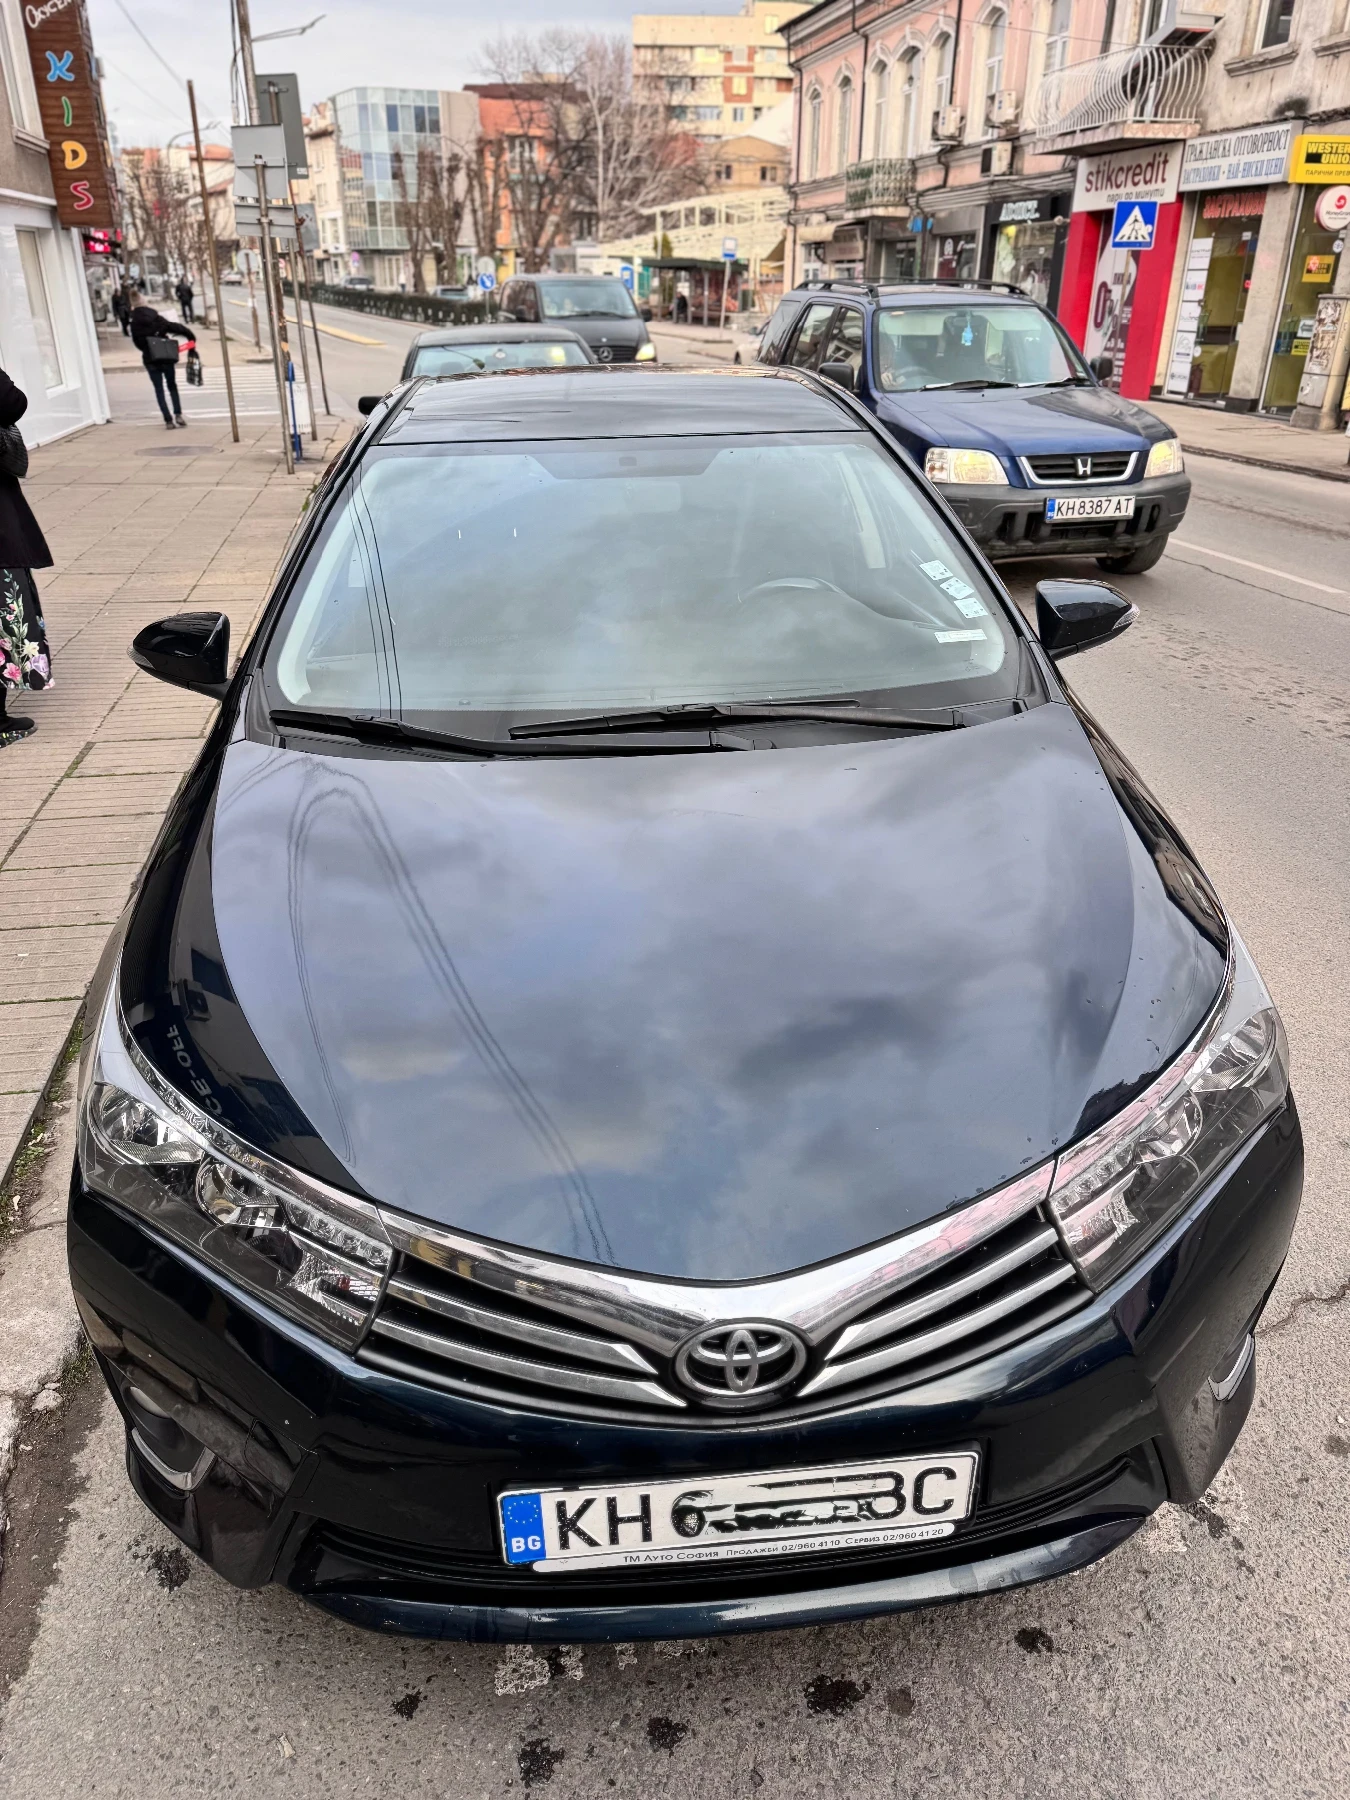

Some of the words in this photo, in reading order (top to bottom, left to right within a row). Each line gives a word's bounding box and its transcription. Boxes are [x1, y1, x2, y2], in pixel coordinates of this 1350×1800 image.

[46, 51, 94, 210] KIDS
[1185, 138, 1232, 164] ГРАЖДАНСКА
[1233, 128, 1290, 156] ОТГОВОРНОСТ
[1321, 153, 1350, 164] UNIO
[1085, 151, 1169, 192] stikcredit
[1056, 501, 1076, 517] KH
[1077, 499, 1112, 516] 8387
[1113, 498, 1133, 514] AT
[556, 1493, 653, 1550] KH
[511, 1535, 542, 1552] BG
[782, 1541, 815, 1552] 02/960
[883, 1531, 916, 1542] 02/960
